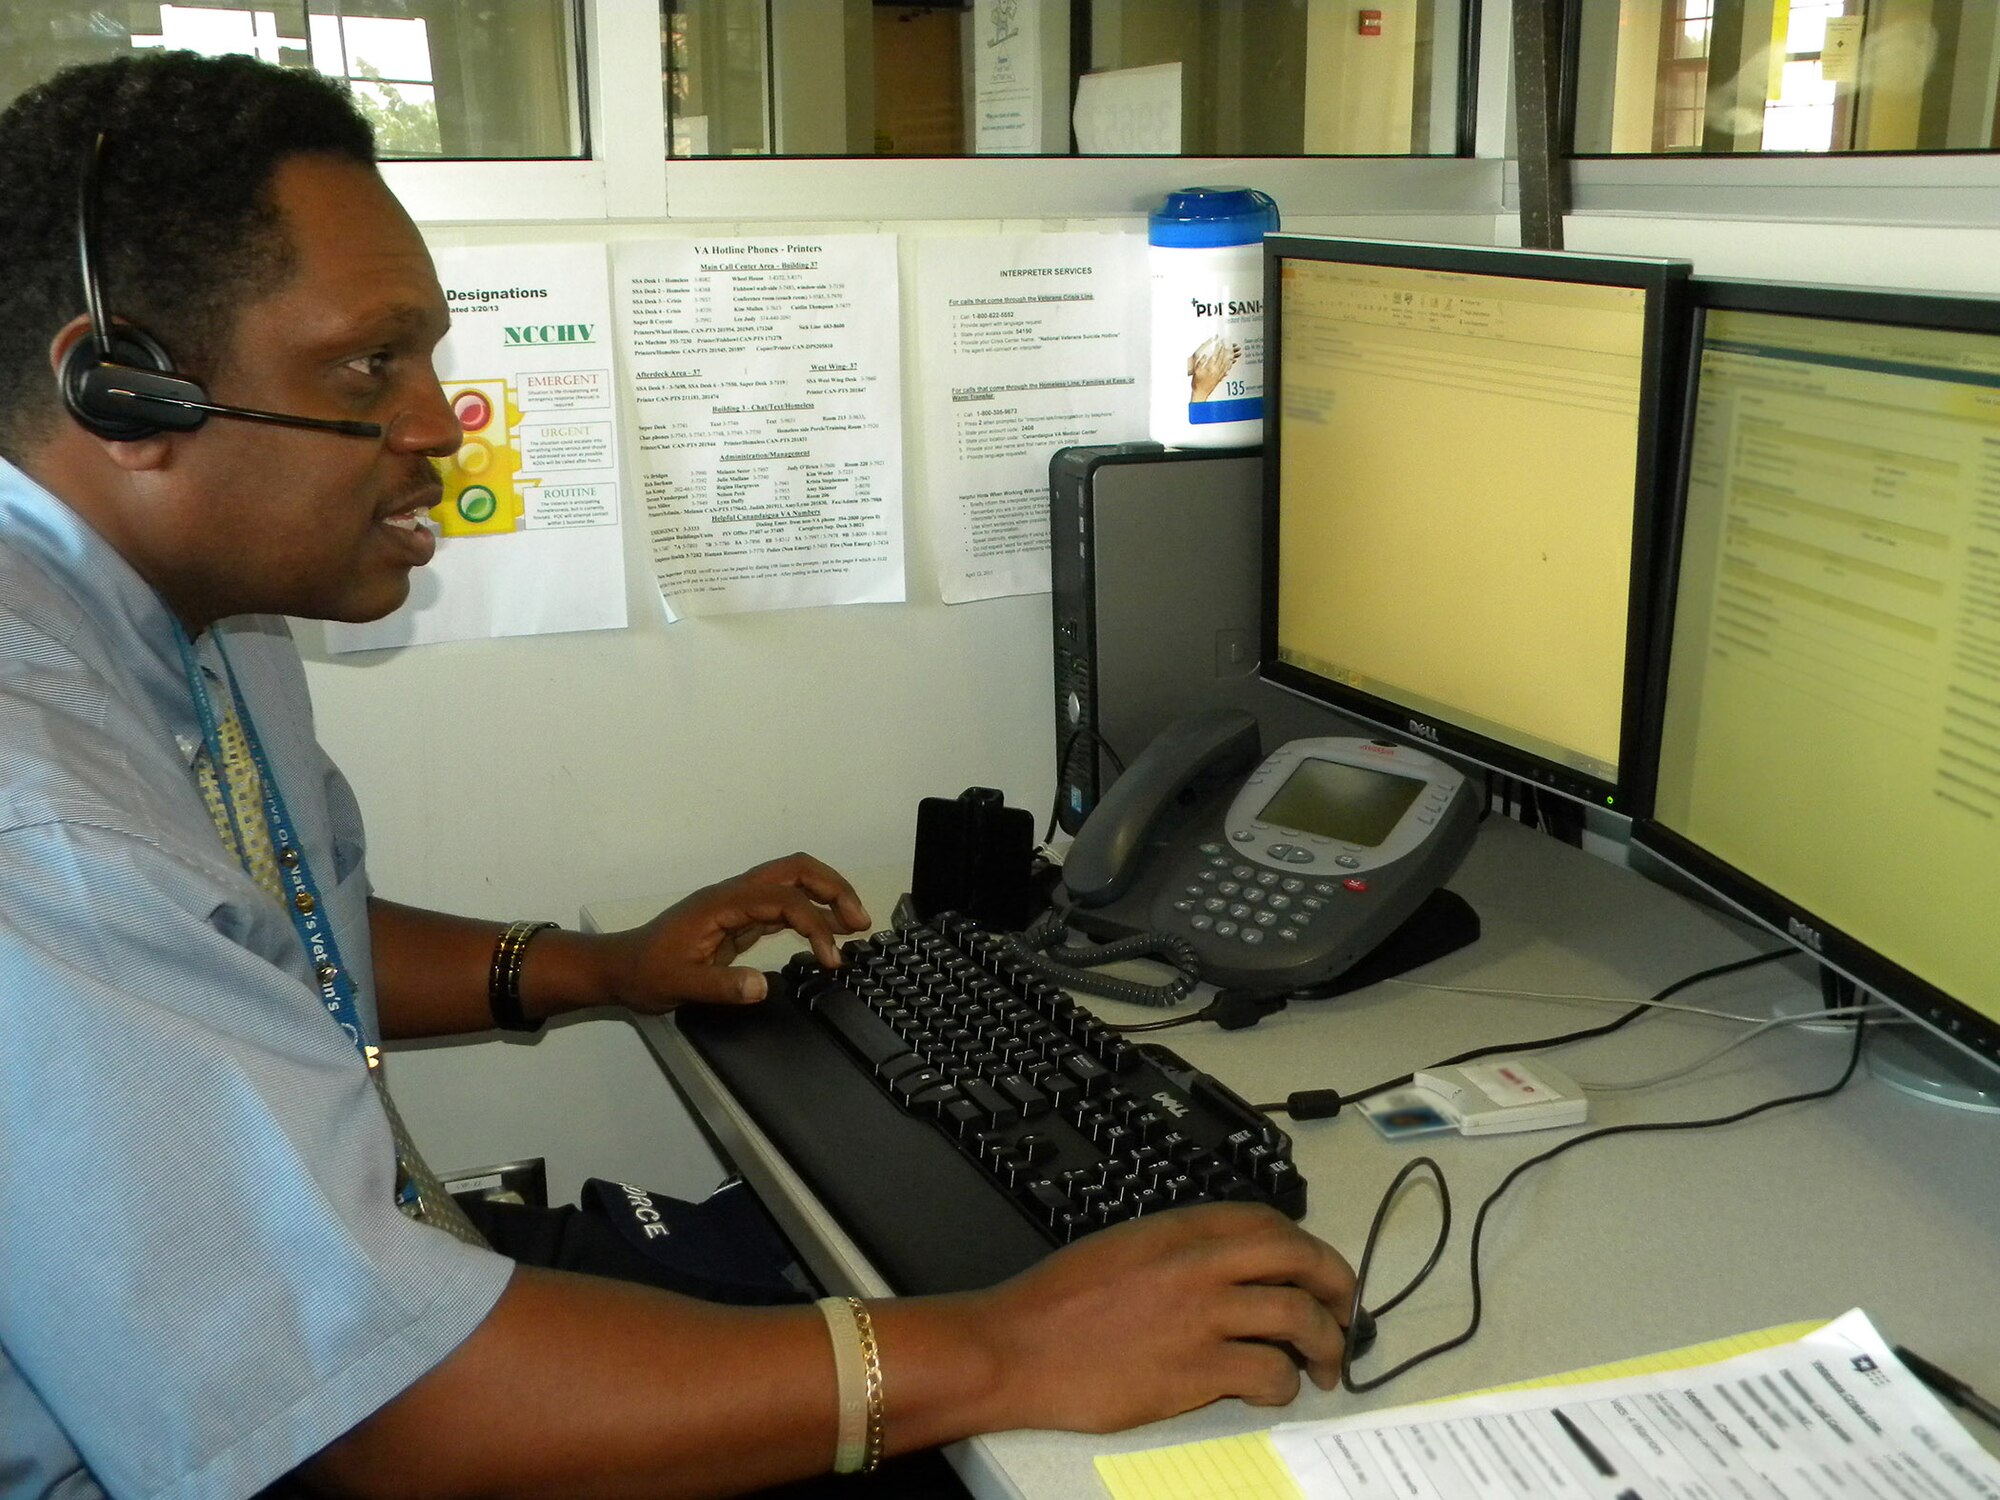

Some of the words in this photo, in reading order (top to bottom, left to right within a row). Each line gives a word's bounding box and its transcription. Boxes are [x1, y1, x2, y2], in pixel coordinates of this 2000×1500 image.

[695, 246, 709, 254] VA
[712, 246, 745, 254] Hotline
[788, 245, 822, 253] Printers
[1000, 268, 1053, 277] INTERPRETER
[1055, 267, 1092, 275] SERVICES
[446, 288, 548, 302] Designations
[504, 324, 594, 344] NCCHV
[528, 374, 599, 387] EMERGENT
[1226, 380, 1244, 396] 135
[540, 426, 591, 438] URGENT
[721, 451, 811, 462] Administration/Management
[544, 488, 597, 499] ROUTINE
[1409, 719, 1440, 742] DELL
[1152, 1092, 1190, 1118] DELL
[618, 1181, 670, 1240] ORCE
